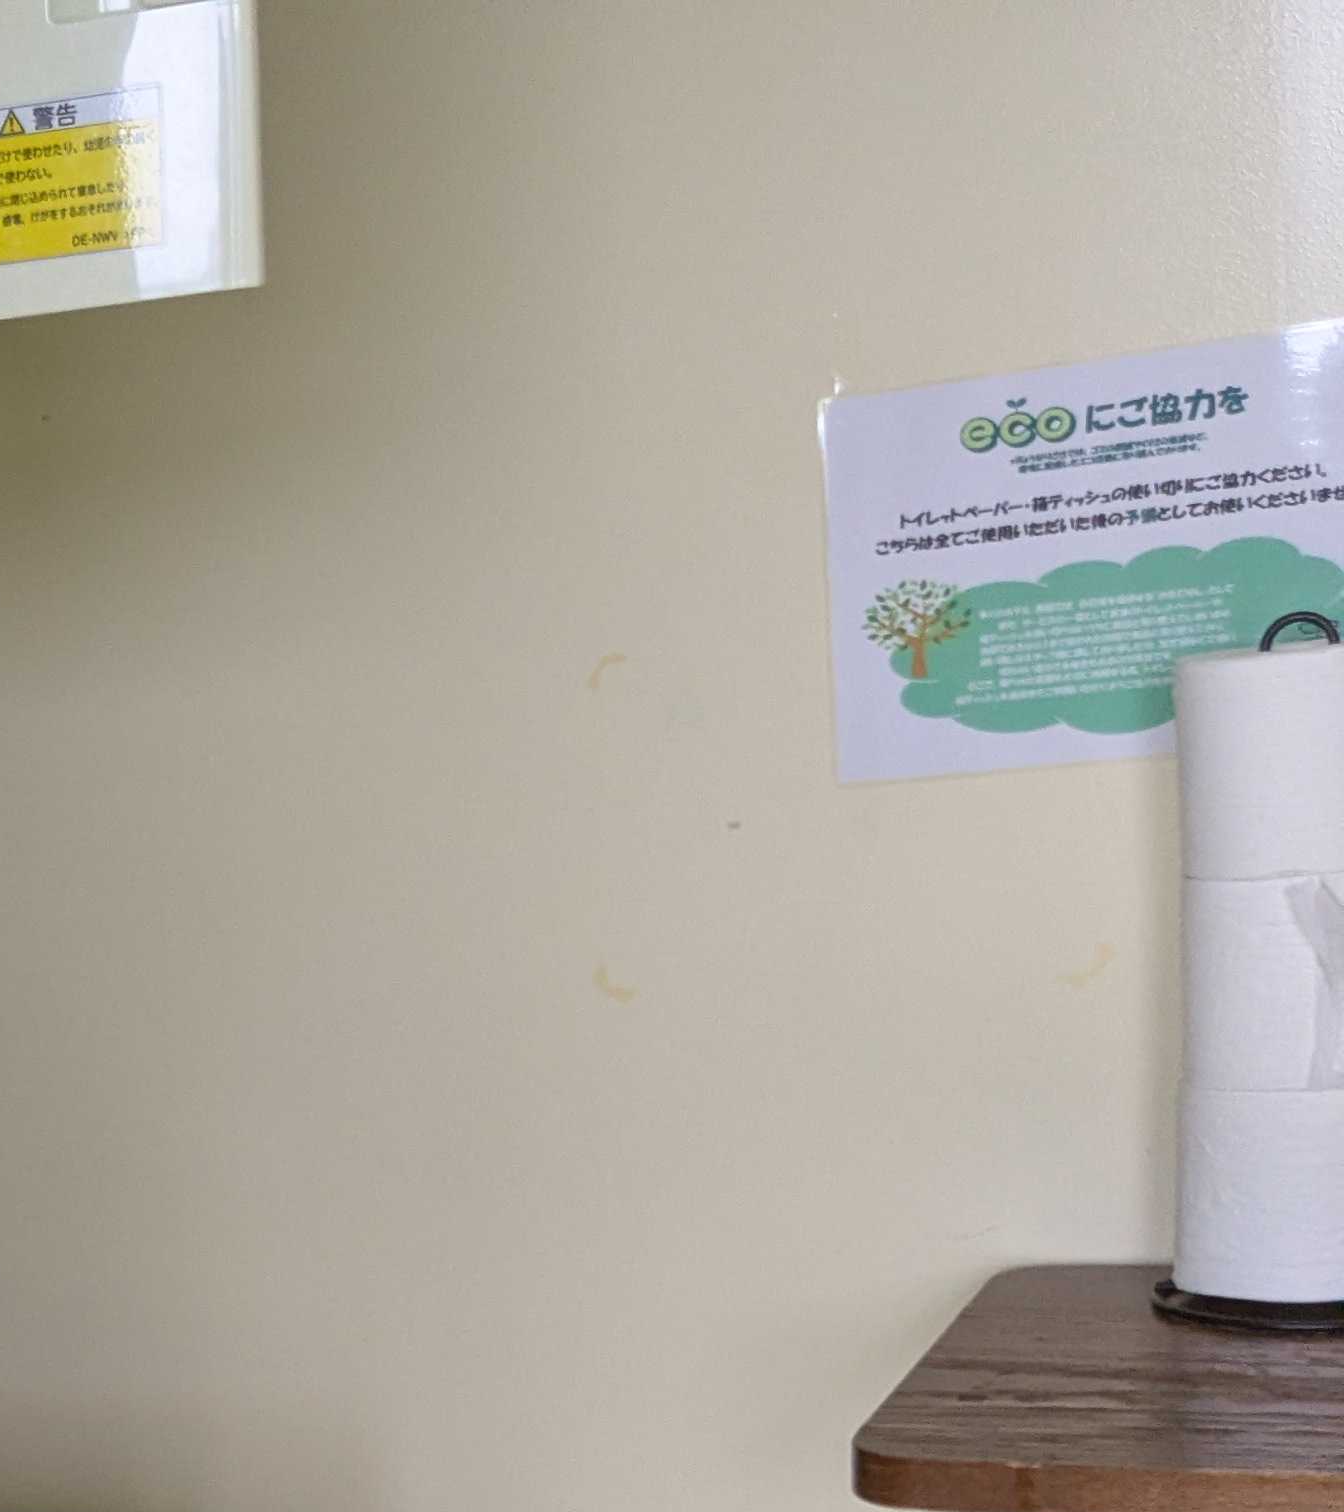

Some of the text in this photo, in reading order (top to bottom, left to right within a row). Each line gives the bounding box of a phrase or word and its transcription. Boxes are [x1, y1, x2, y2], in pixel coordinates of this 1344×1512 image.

[32, 103, 78, 130] 警告
[960, 404, 1077, 454] eco
[1084, 385, 1250, 434] にご協力を
